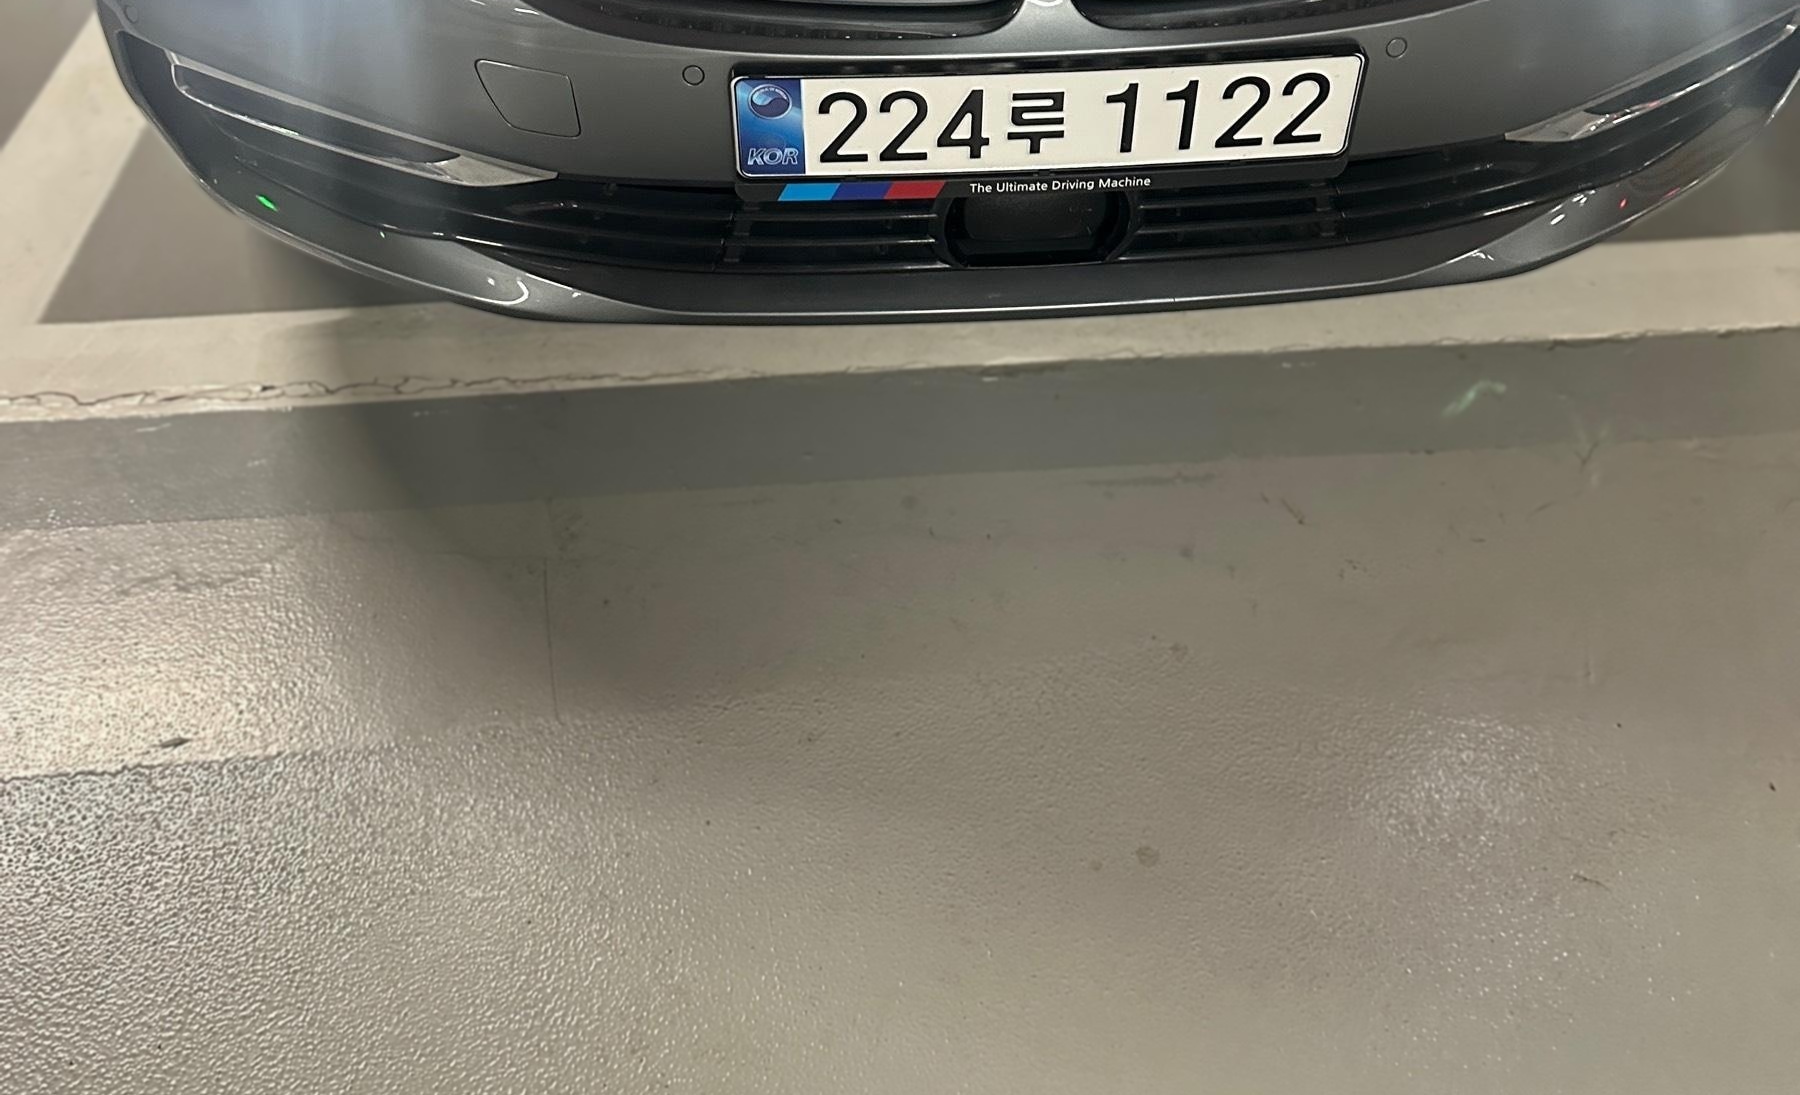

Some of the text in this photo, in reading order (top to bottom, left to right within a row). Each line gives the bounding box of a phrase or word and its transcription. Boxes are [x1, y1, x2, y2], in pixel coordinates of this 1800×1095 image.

[818, 72, 1332, 164] 224루 1122
[748, 148, 799, 165] KOR
[970, 177, 1151, 193] The Ultimate Driving Machine
